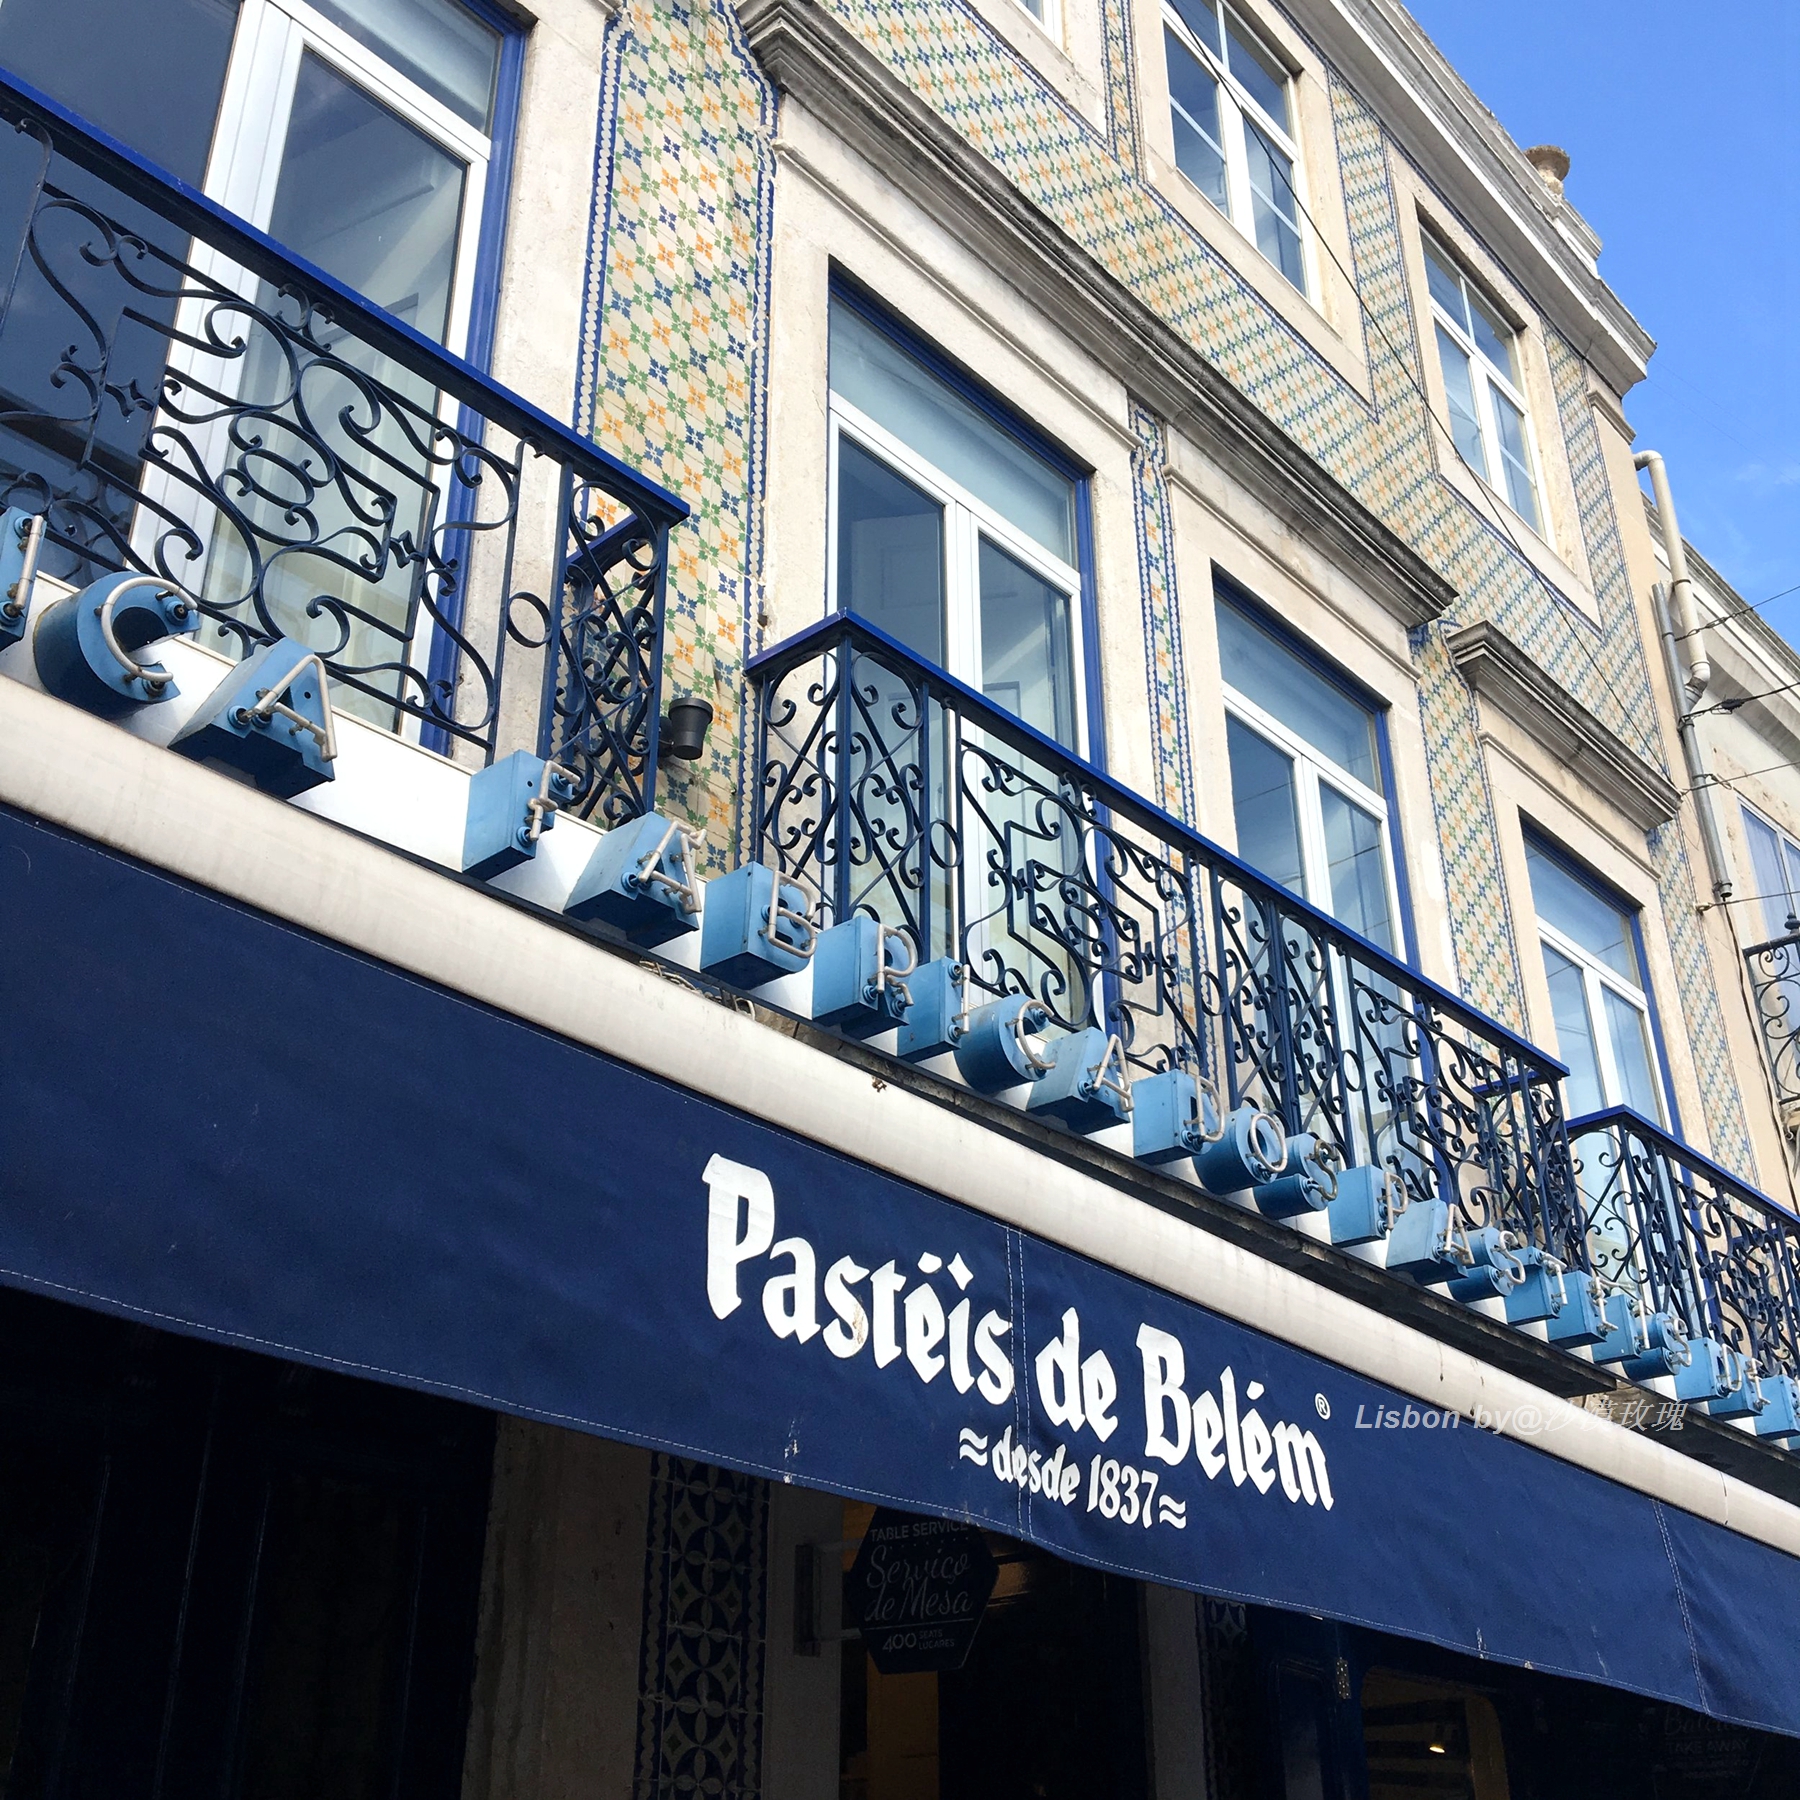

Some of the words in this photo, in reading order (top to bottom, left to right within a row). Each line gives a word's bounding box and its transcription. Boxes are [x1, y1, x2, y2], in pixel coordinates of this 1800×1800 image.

[1132, 1068, 1339, 1220] DOS
[702, 1153, 1014, 1405] Pastéis
[1035, 1307, 1118, 1442] de
[992, 1425, 1081, 1506] desde
[1086, 1454, 1159, 1528] 1837
[870, 1524, 909, 1542] TABLE
[867, 1545, 971, 1588] Serviço
[864, 1579, 896, 1621] de
[900, 1577, 973, 1620] Mesa
[882, 1632, 917, 1652] 400
[919, 1629, 943, 1639] SEATS
